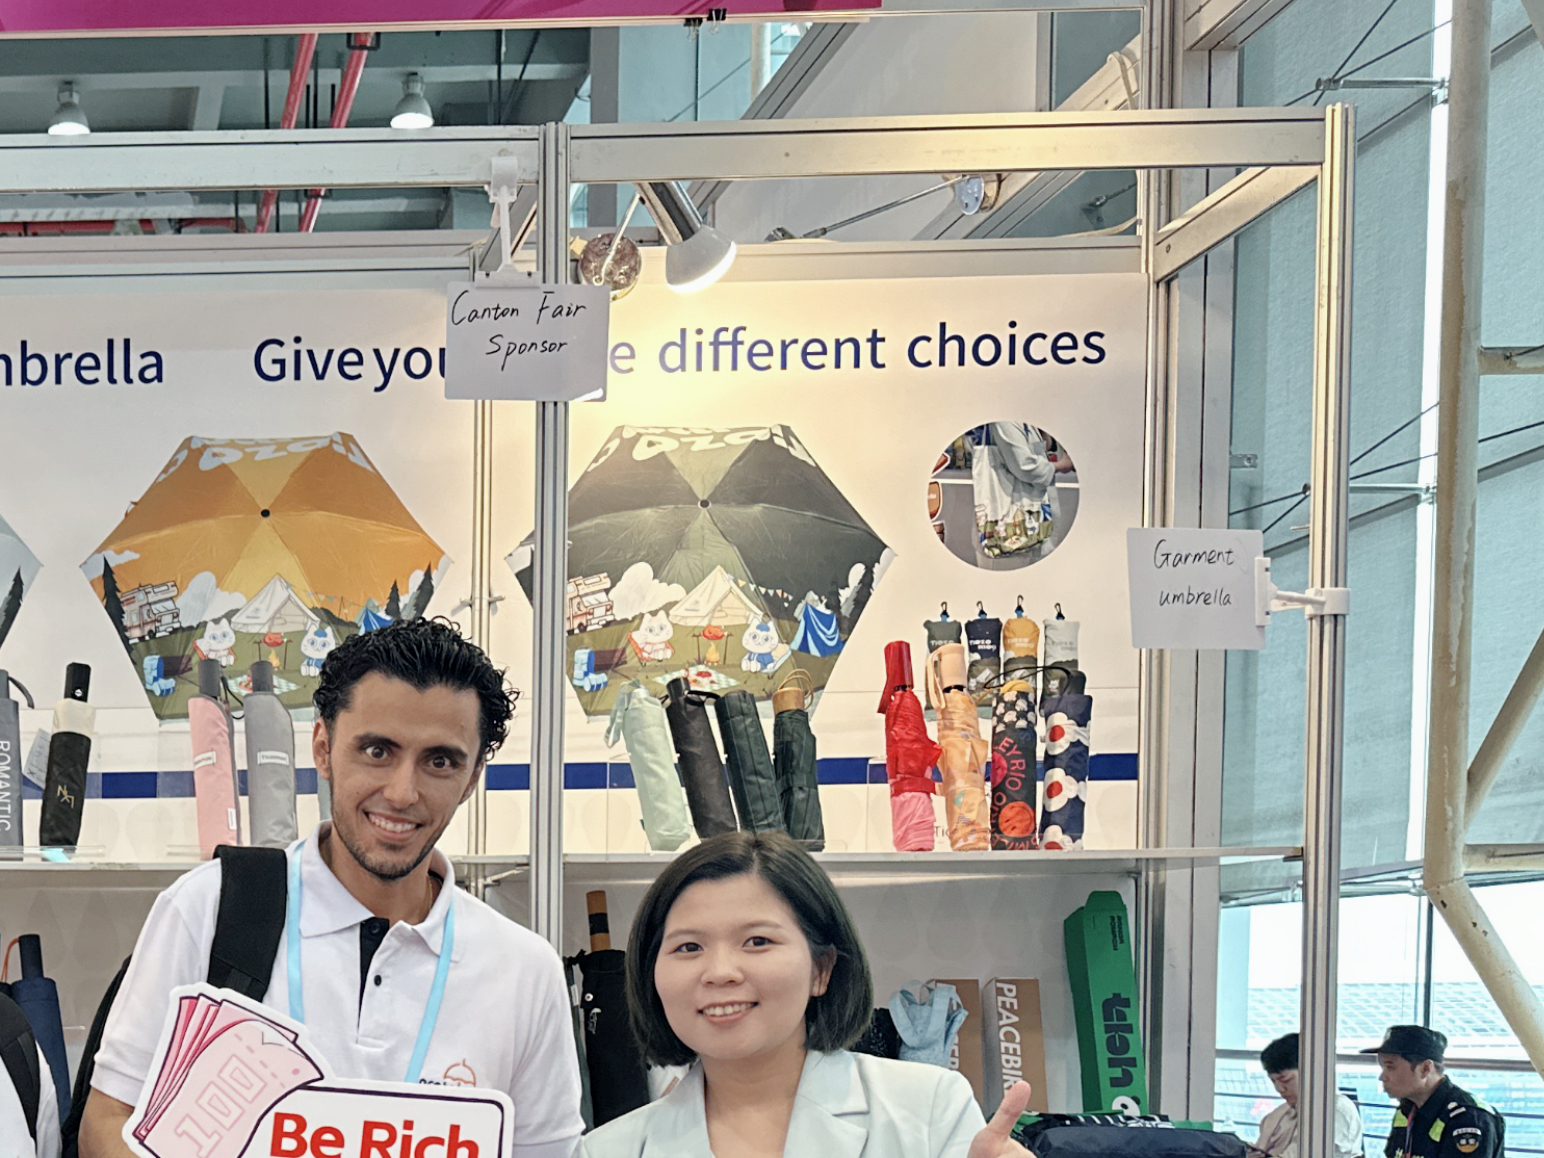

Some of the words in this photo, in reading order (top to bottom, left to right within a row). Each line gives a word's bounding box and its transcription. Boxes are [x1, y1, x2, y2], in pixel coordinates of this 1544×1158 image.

[451, 290, 519, 325] Canton
[536, 291, 587, 324] Fair
[254, 336, 364, 382] Give
[373, 346, 445, 393] yo
[658, 326, 886, 373] different
[907, 320, 1107, 368] choices
[485, 334, 568, 371] Sponsor
[1154, 539, 1234, 569] Garment
[1159, 585, 1232, 607] umbrella
